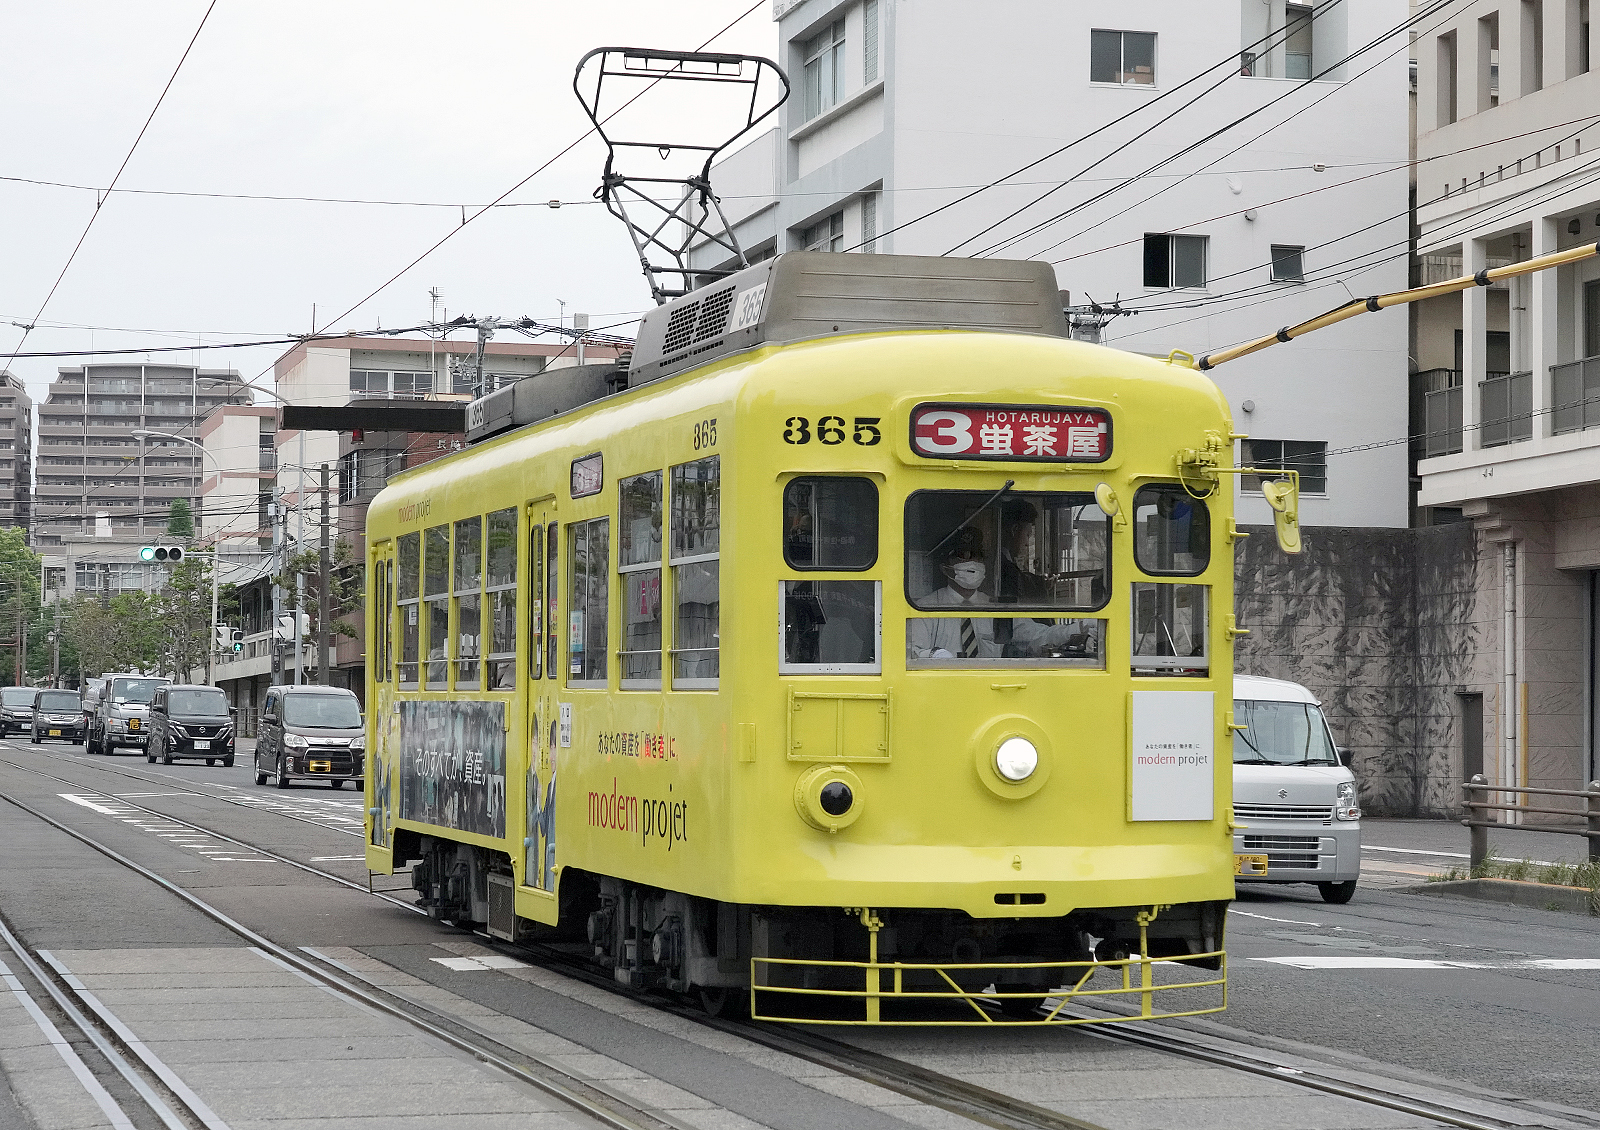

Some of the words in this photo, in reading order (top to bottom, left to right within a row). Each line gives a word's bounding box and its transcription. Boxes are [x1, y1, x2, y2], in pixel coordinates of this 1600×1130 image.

[739, 289, 765, 327] 365
[783, 416, 881, 446] 365
[915, 411, 974, 454] 3
[986, 411, 1095, 424] HOTARUJAYA
[693, 418, 717, 450] 365
[979, 423, 1101, 457] 蛍茶屋
[398, 499, 415, 523] modern
[129, 718, 140, 730] 危
[415, 748, 486, 785] そのすべてが、資産。
[1137, 753, 1176, 765] modern
[1178, 752, 1208, 767] projet
[588, 777, 638, 833] modern
[642, 783, 687, 852] projet
